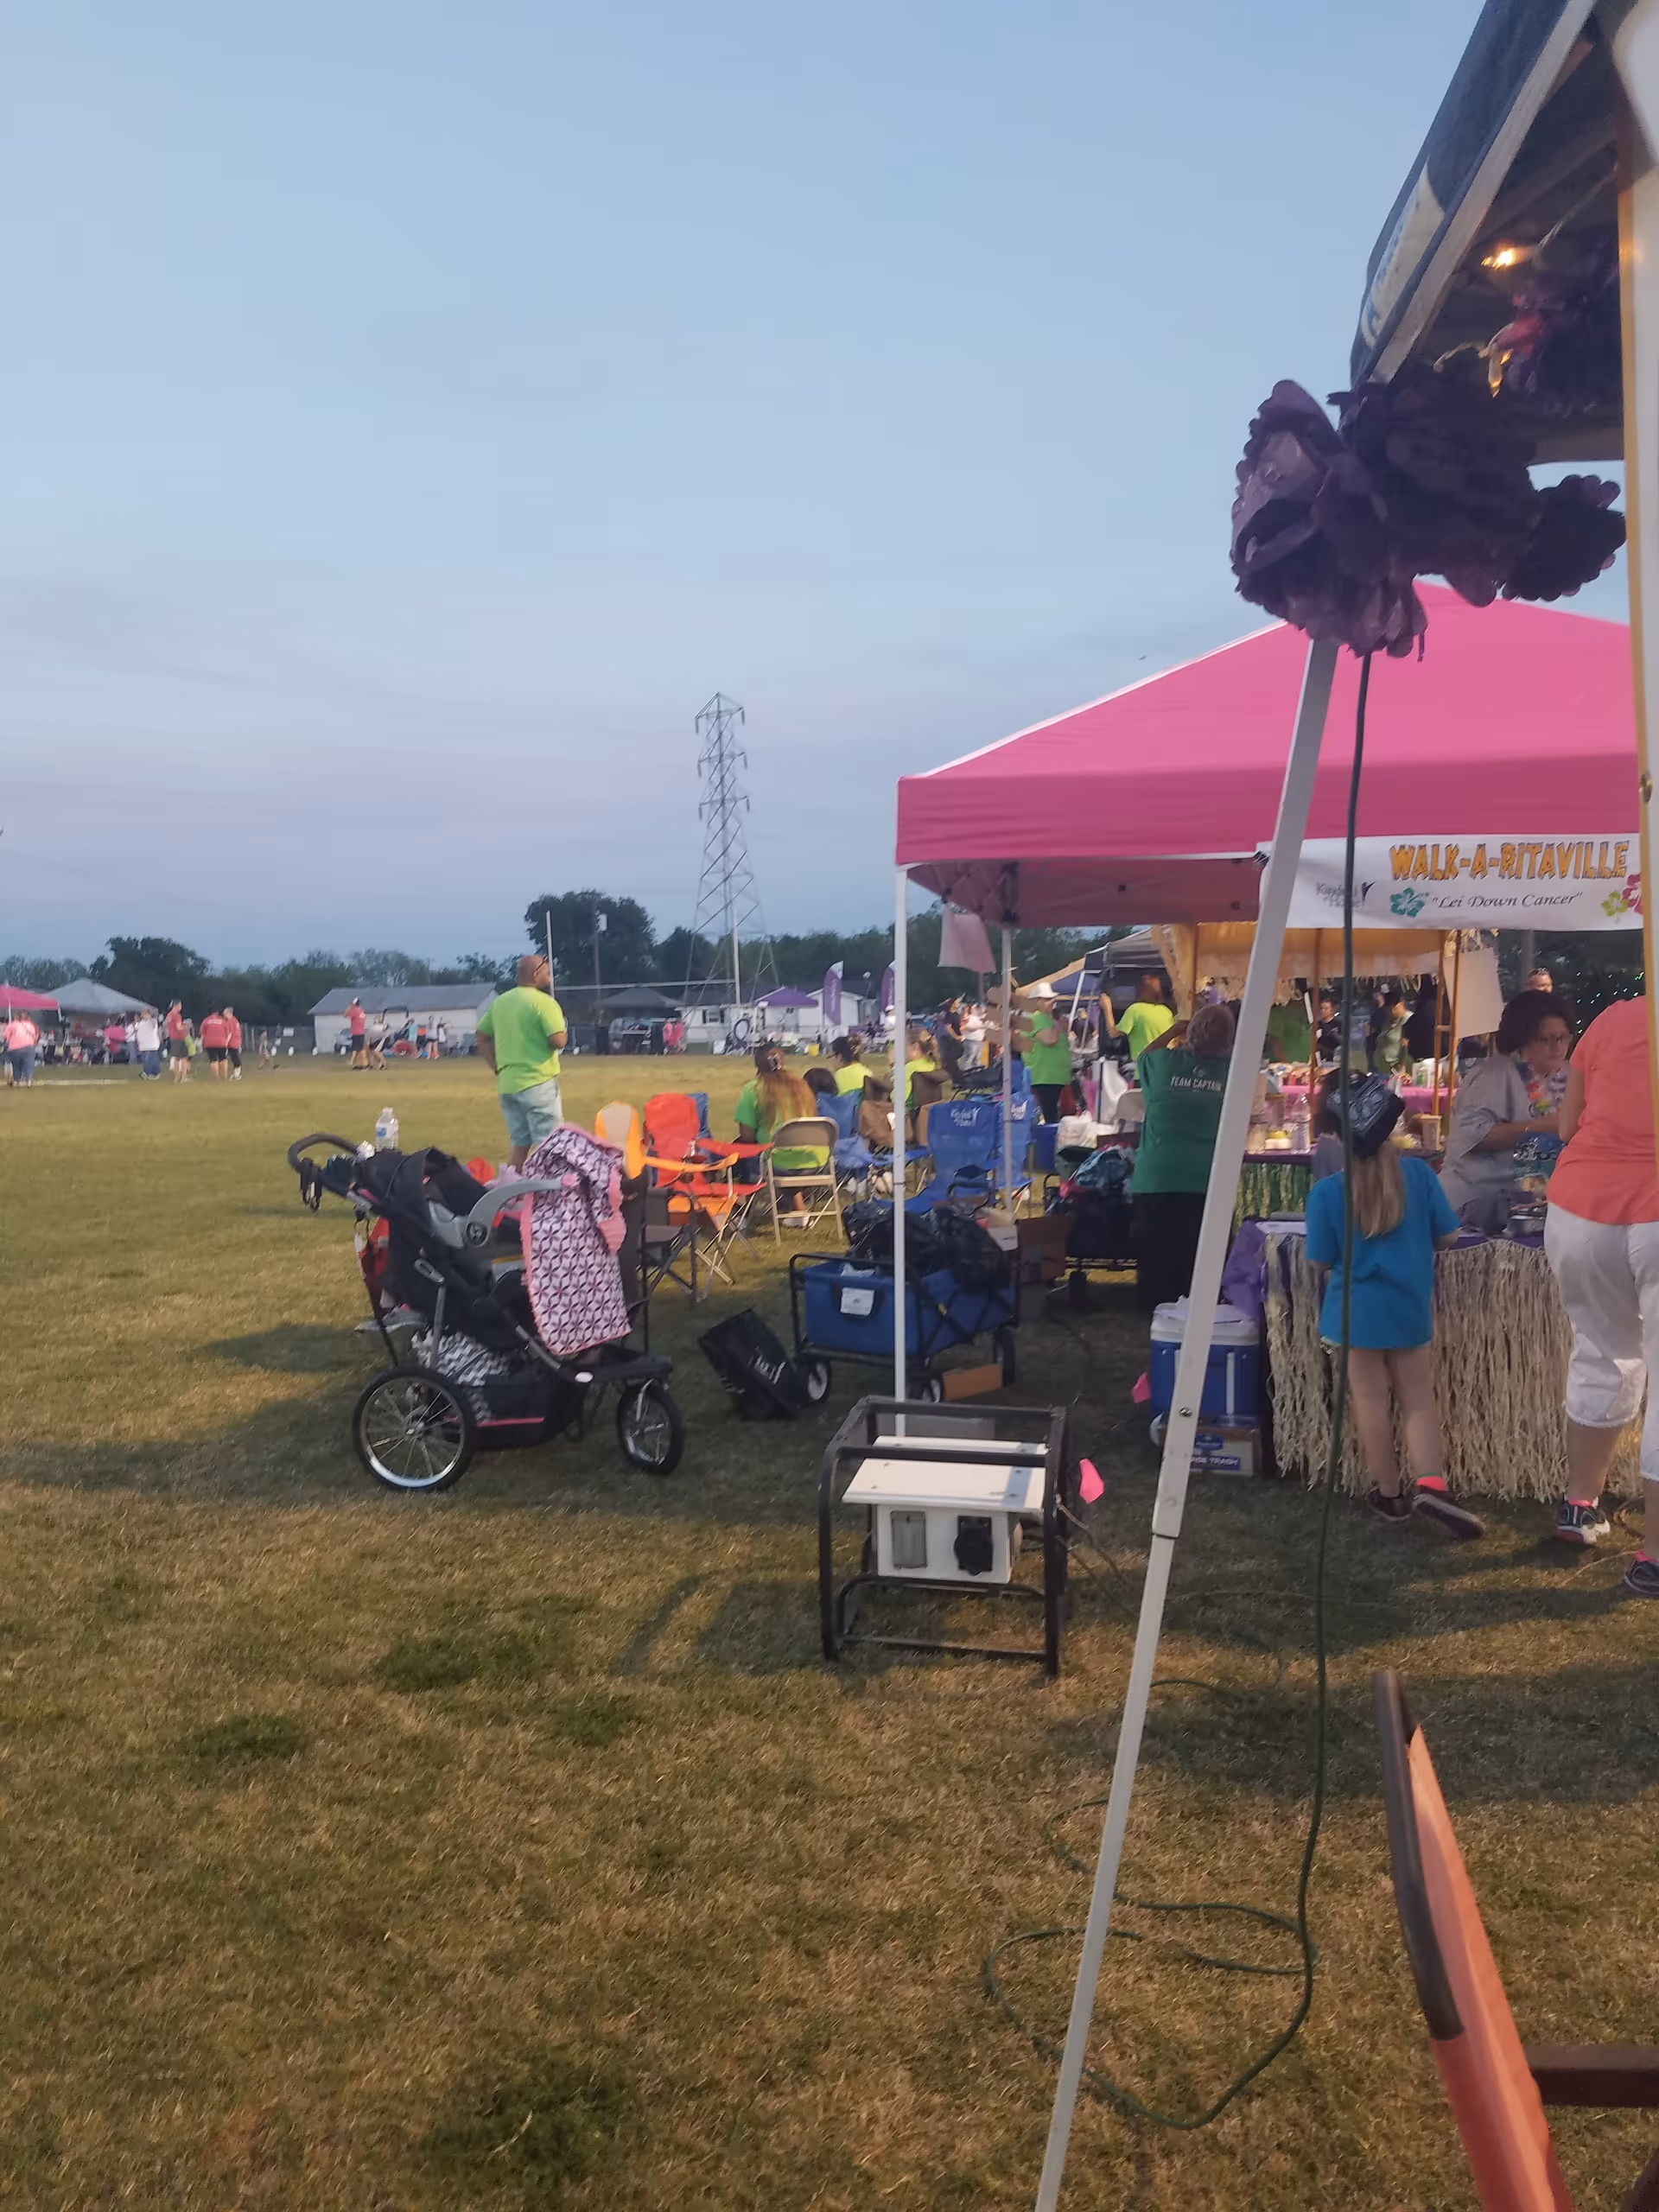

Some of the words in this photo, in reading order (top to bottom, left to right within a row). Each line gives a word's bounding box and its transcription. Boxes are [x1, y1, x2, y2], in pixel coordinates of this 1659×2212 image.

[1389, 840, 1630, 880] WALK-A-RITAVILLE
[1468, 894, 1518, 908] Down
[1522, 892, 1584, 908] Cancer"
[1170, 1075, 1191, 1087] TEAM
